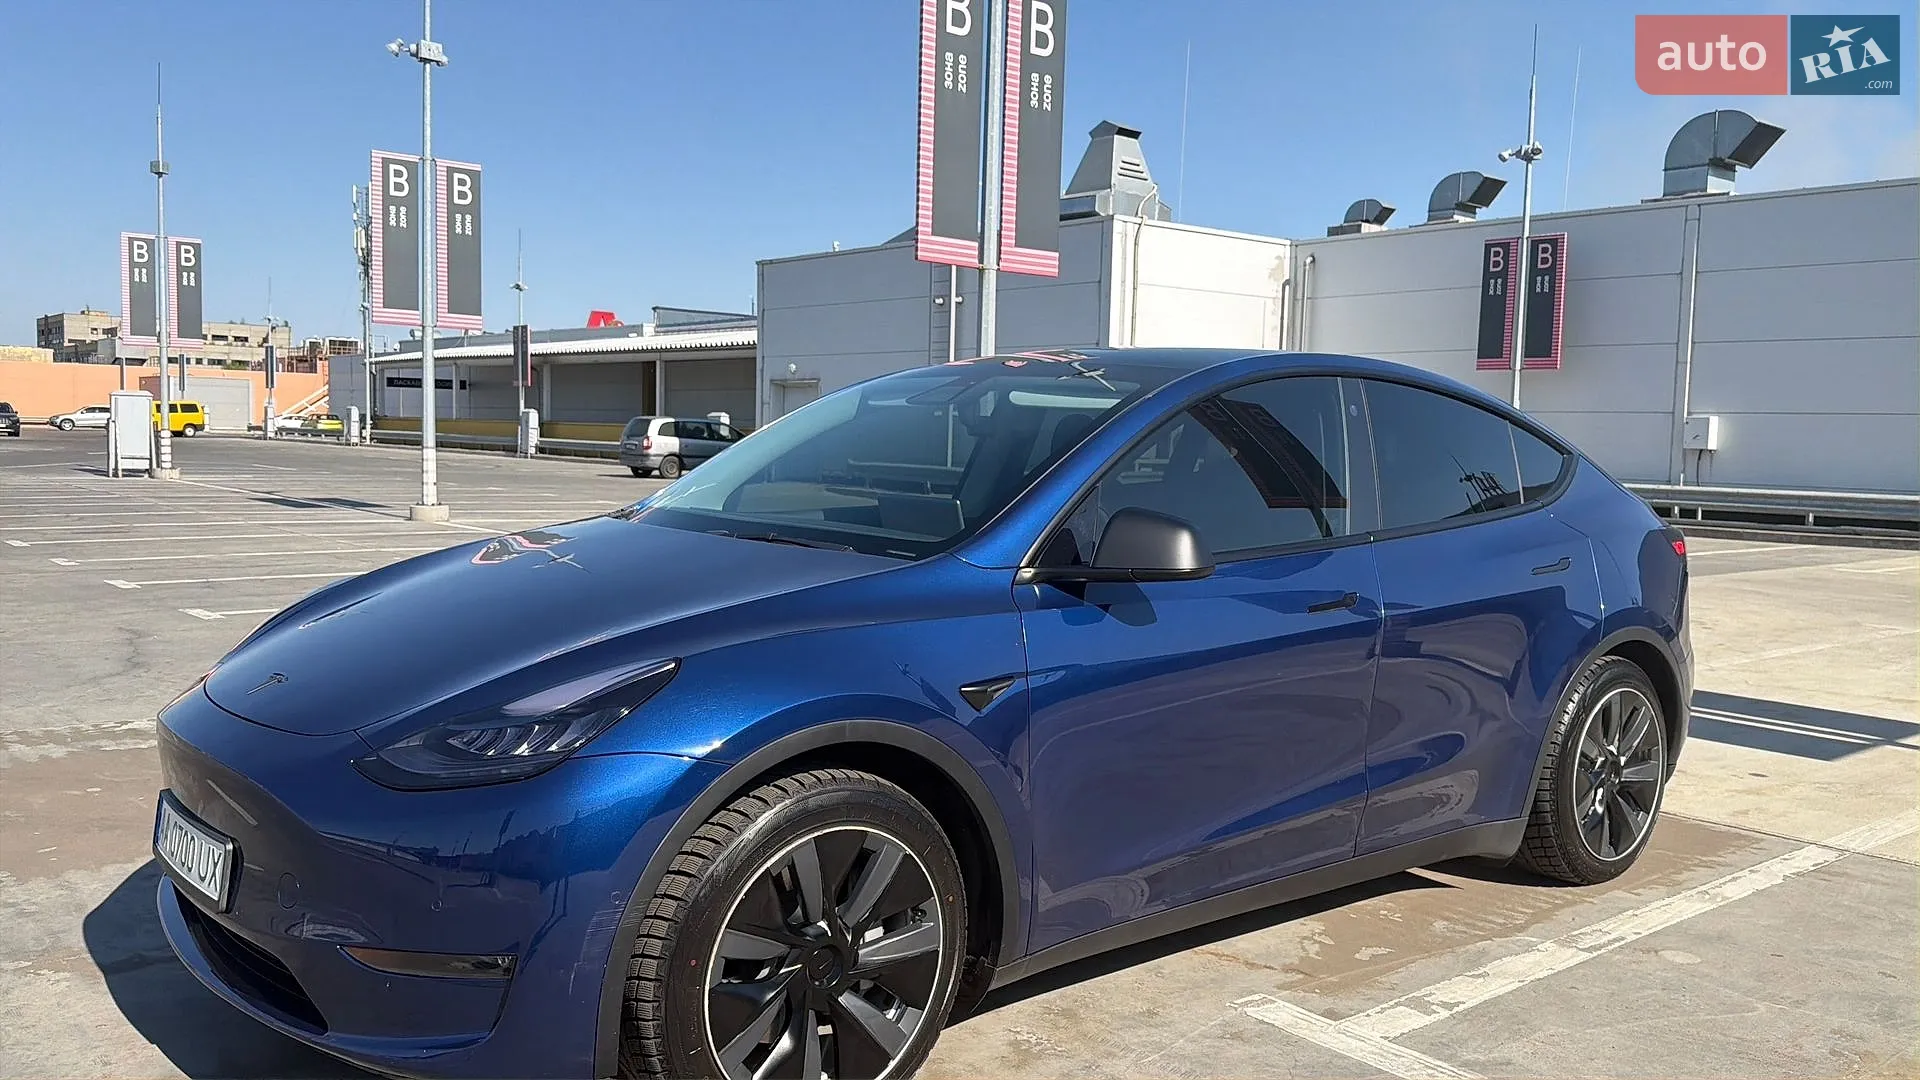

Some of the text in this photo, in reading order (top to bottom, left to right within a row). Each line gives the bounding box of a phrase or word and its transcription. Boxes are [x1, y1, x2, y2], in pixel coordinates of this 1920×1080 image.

[944, 51, 954, 90] зона
[957, 54, 968, 94] zone
[1030, 72, 1040, 109] зона
[1043, 74, 1053, 111] zone
[171, 820, 197, 873] 0700
[198, 840, 223, 893] UX
